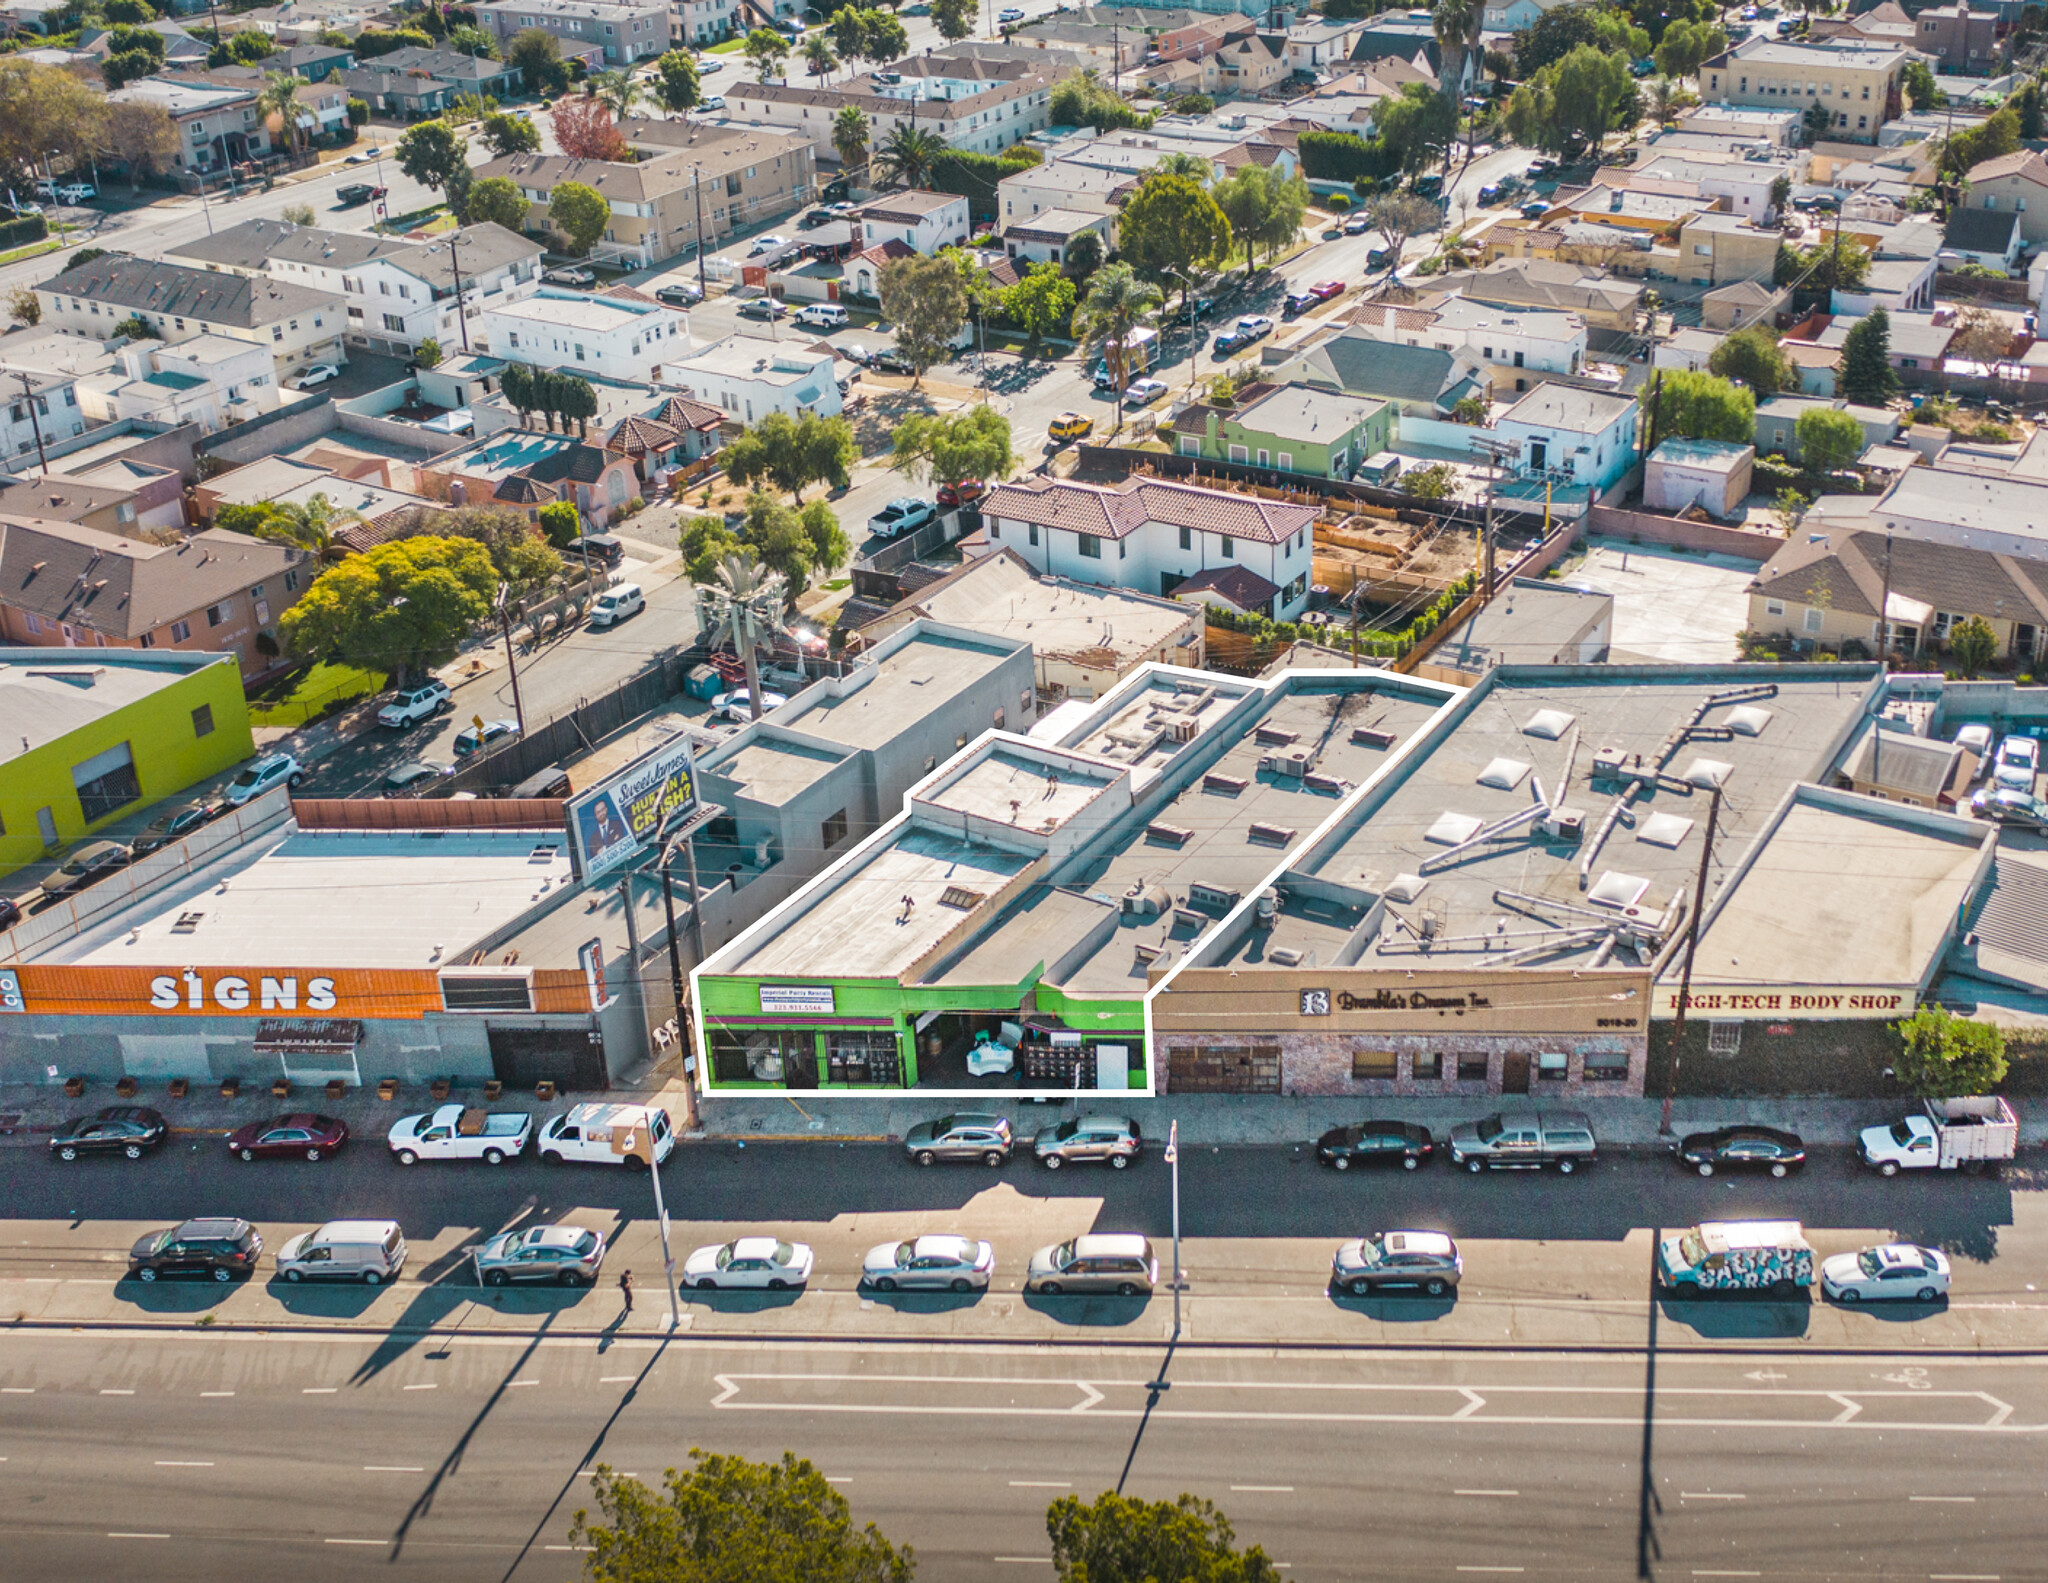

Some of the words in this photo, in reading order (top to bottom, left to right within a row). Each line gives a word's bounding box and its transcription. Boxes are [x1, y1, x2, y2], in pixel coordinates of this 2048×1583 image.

[618, 770, 651, 804] Sweet
[666, 777, 678, 794] IN
[680, 770, 689, 784] A
[1789, 994, 1845, 1009] BODY
[1848, 994, 1903, 1009] SHOP
